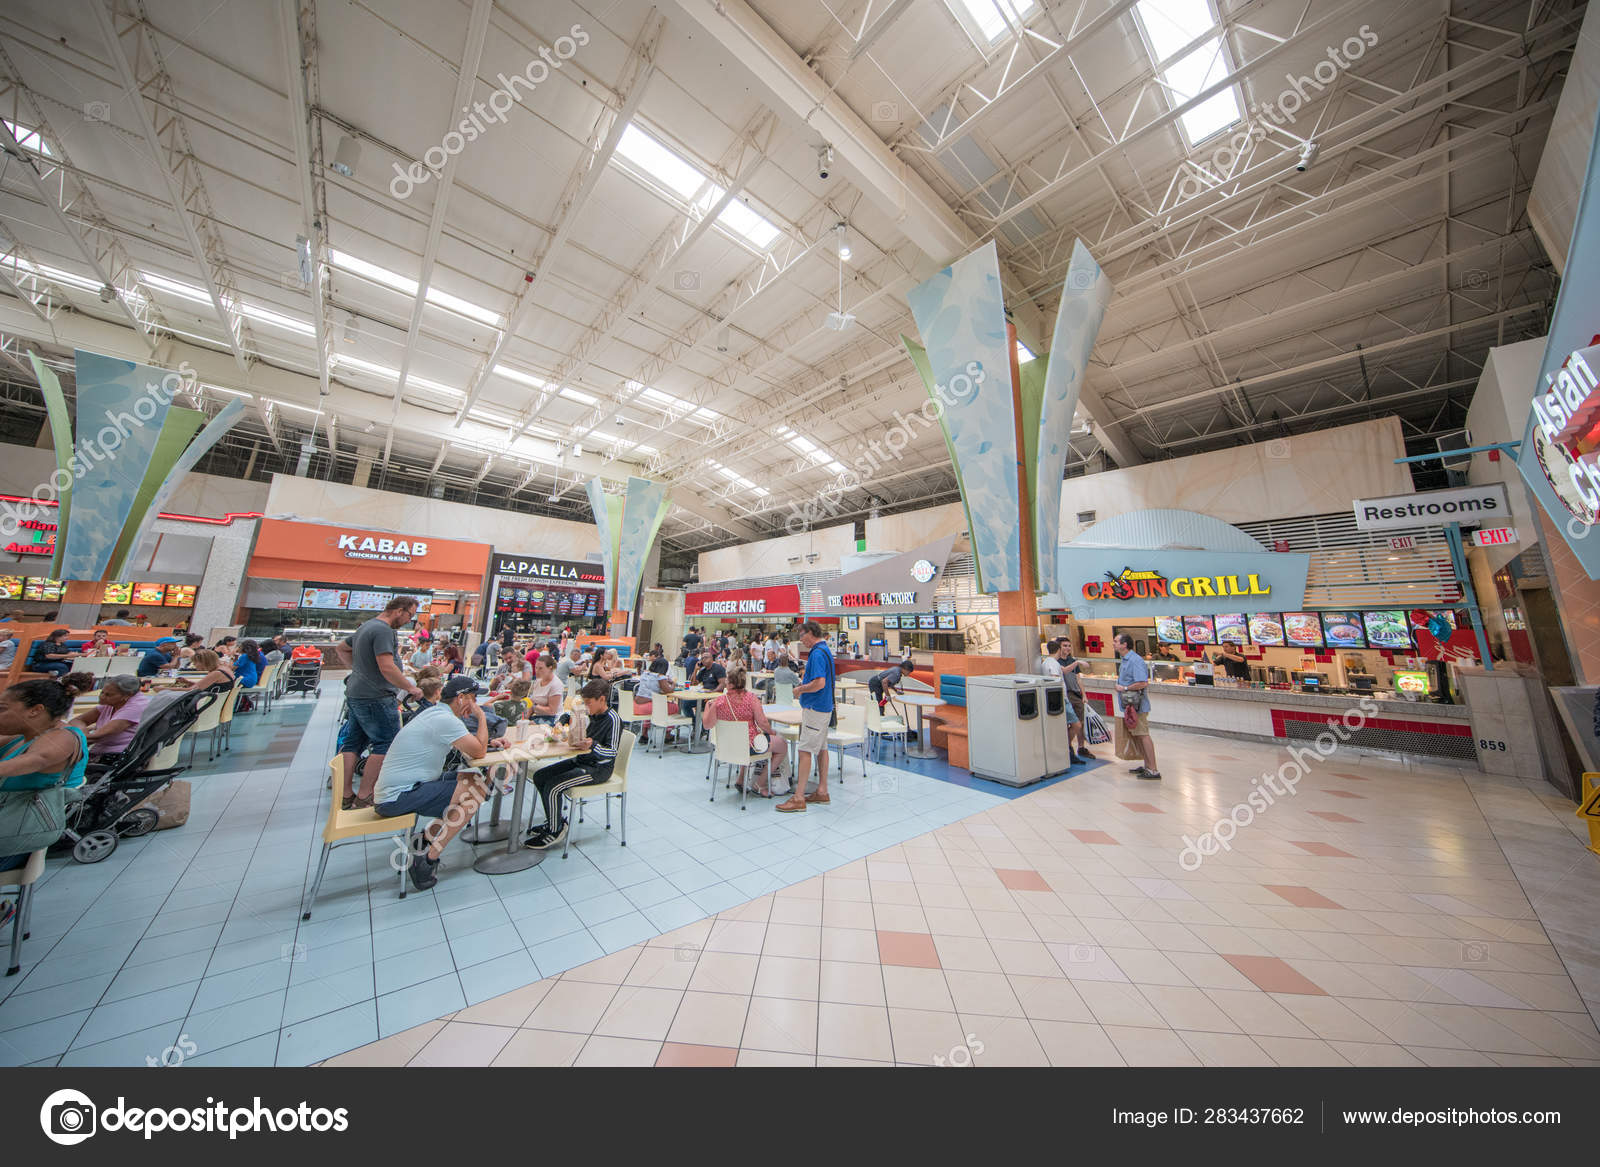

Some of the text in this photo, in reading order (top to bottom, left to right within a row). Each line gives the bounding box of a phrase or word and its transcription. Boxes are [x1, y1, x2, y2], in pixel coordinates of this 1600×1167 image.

[1532, 350, 1600, 445] Asian
[1364, 497, 1497, 521] Restrooms
[338, 534, 428, 556] KABAB
[1391, 536, 1413, 550] EXIT
[1479, 528, 1510, 545] EXIT
[348, 551, 380, 560] CHICKEN
[501, 560, 516, 570] LA
[518, 561, 578, 579] PAELLA
[1081, 573, 1271, 600] CAJUN GRILL
[703, 599, 766, 614] BURGER KING
[828, 591, 917, 608] THE GRILL FACTORY
[1480, 739, 1506, 752] 859
